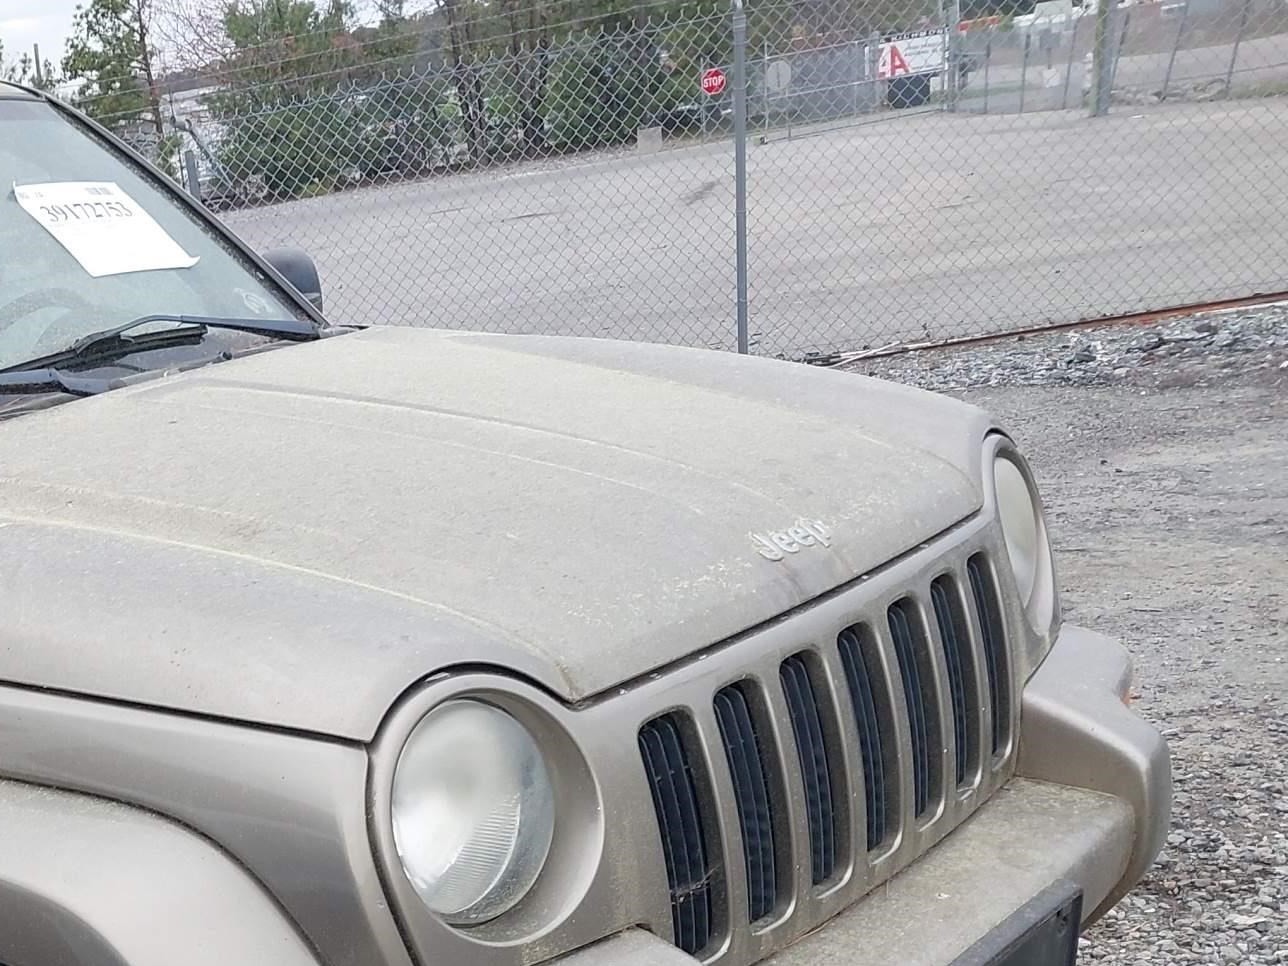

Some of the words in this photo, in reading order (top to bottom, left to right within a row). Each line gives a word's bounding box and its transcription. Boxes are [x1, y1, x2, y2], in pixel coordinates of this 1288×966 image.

[703, 75, 724, 88] STOP
[40, 201, 133, 222] 39172753
[752, 518, 832, 562] Jeep
